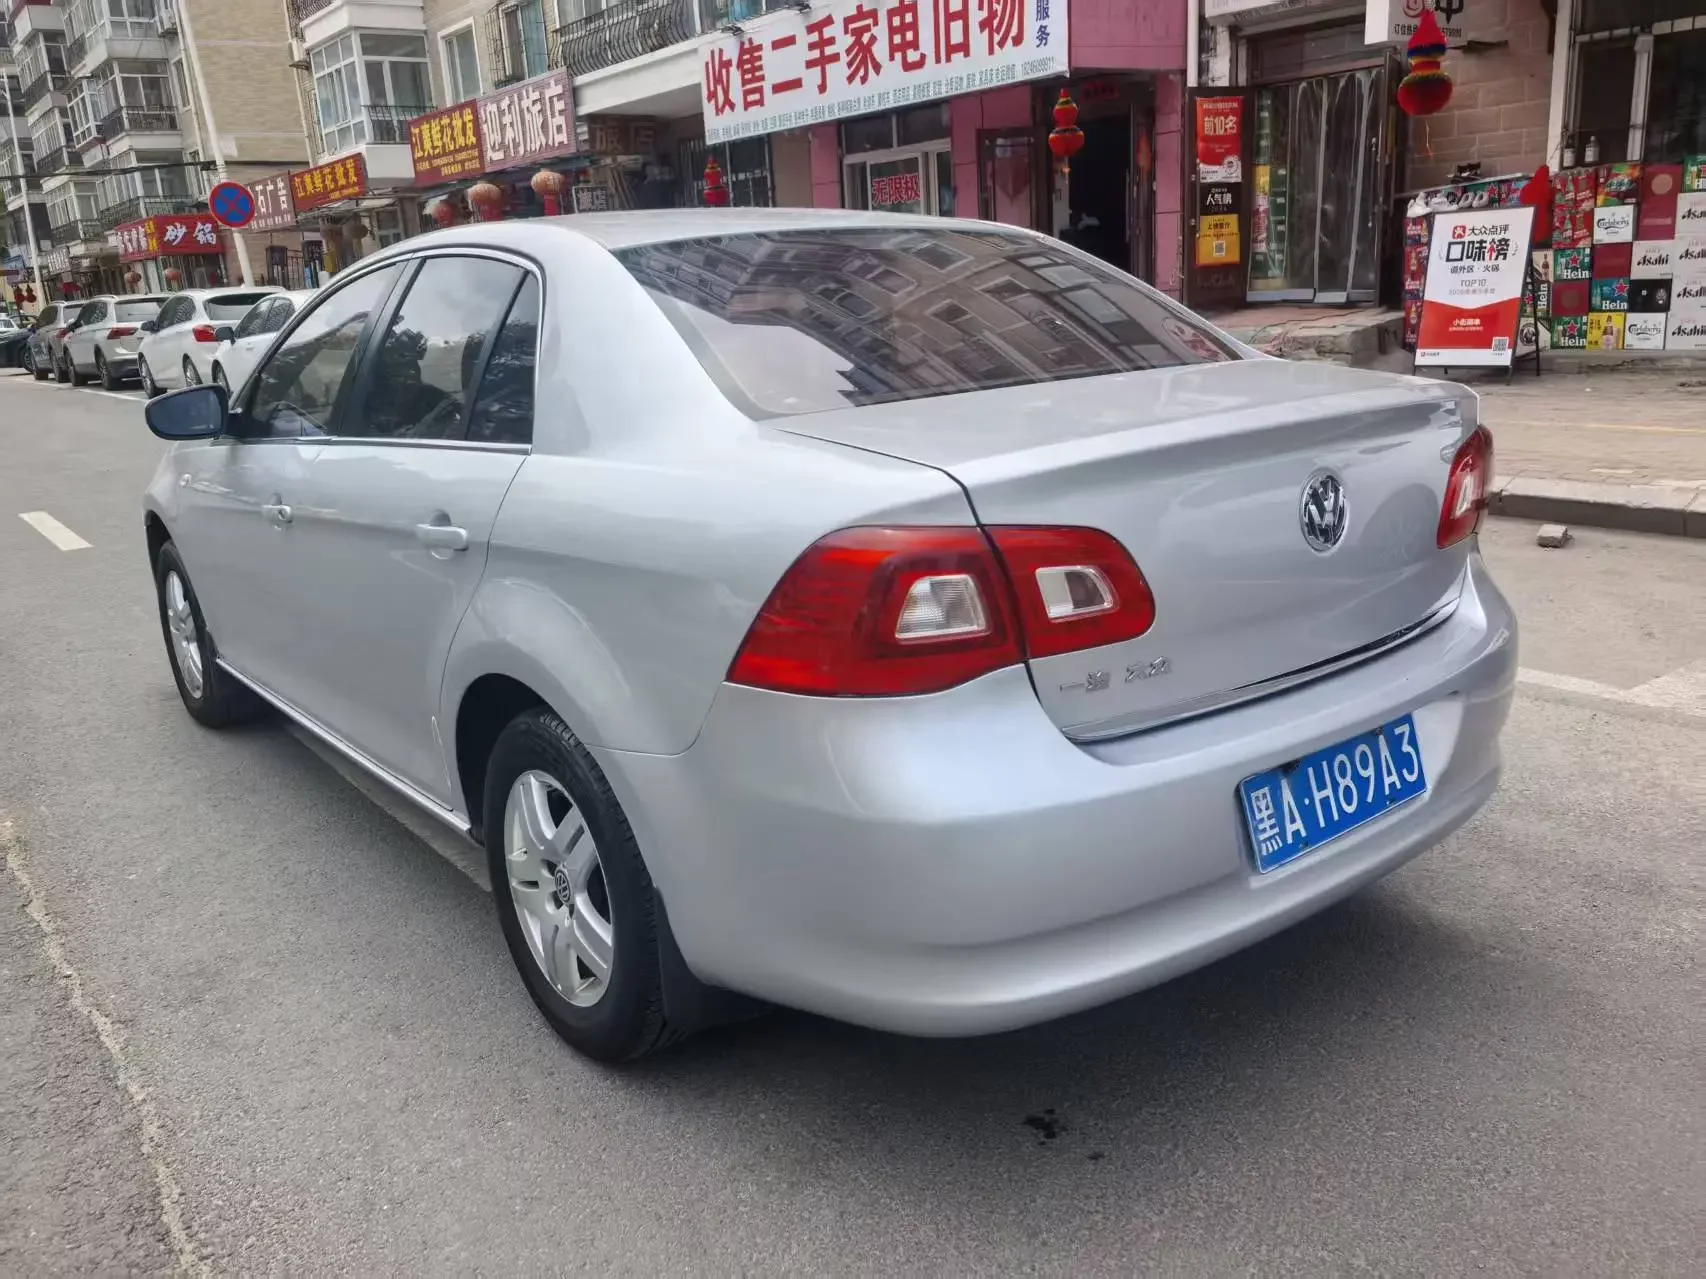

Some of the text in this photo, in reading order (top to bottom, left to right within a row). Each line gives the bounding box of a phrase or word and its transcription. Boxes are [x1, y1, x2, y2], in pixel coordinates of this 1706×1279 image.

[704, 0, 1025, 117] 收售二手家电旧物
[480, 79, 568, 163] 迎利旅店
[247, 177, 288, 217] 石广告
[871, 173, 921, 206] 无限极
[1467, 224, 1510, 237] 大众点评
[1596, 217, 1630, 231] Carlsberg
[1445, 237, 1511, 263] 口味榜
[1636, 254, 1670, 267] Asahi
[1563, 268, 1590, 280] Hein
[1537, 283, 1549, 310] Hein
[1602, 300, 1628, 311] Hein
[1628, 323, 1662, 336] Carlsberg
[1560, 335, 1587, 348] Hein
[1250, 722, 1420, 857] 黑A·H89A3
